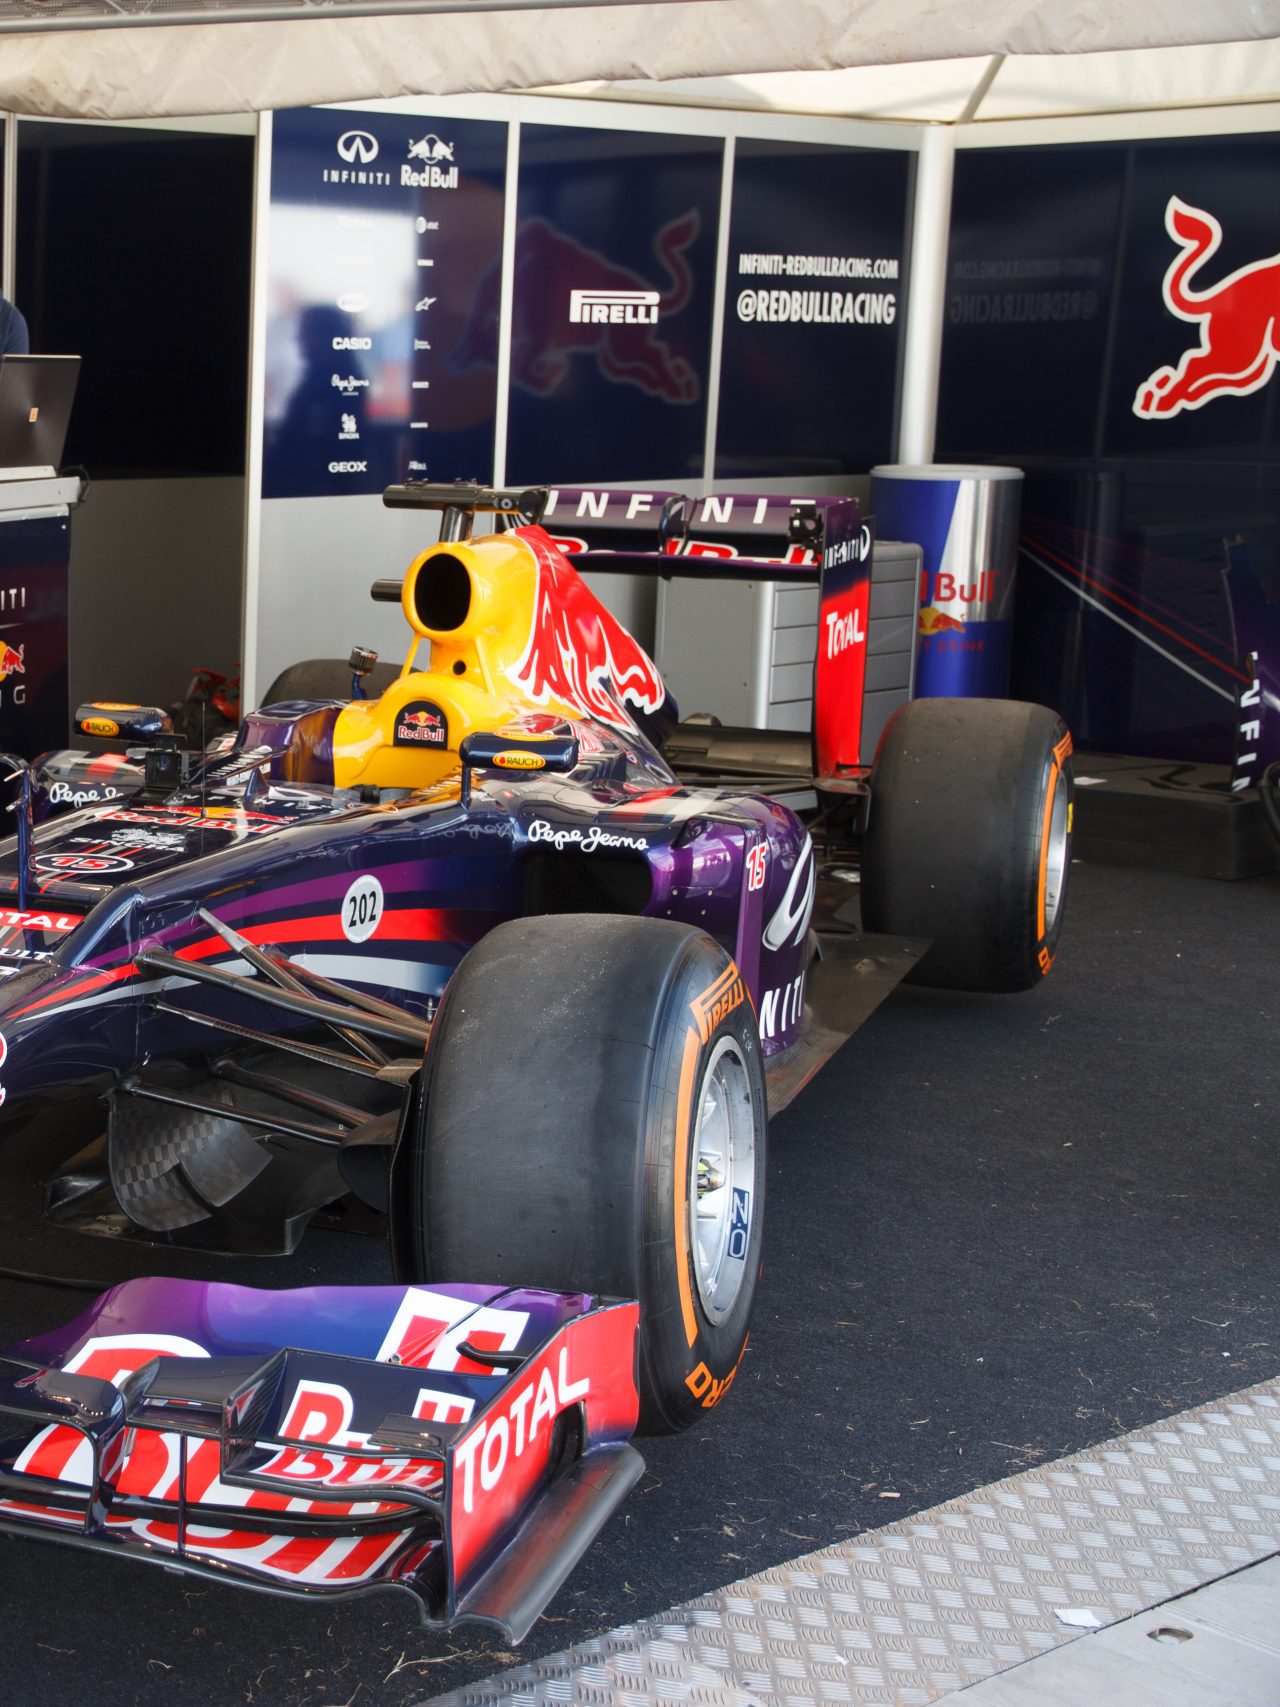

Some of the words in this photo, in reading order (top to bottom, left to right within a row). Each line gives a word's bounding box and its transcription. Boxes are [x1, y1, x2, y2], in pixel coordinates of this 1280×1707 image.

[323, 169, 390, 186] INFINITI
[400, 164, 430, 187] Red
[431, 166, 459, 189] Bull
[739, 253, 899, 280] INFINITI-REDBULLRACING.COM
[569, 289, 661, 324] PIRELLI
[736, 289, 897, 325] @REDBULLRACING
[332, 337, 372, 351] CASIO
[328, 461, 368, 473] GEOX
[934, 572, 995, 604] Bull
[826, 608, 865, 660] TOTAL
[398, 725, 421, 740] Red
[420, 727, 444, 743] Bull
[506, 756, 539, 766] RAUCH
[50, 782, 101, 808] Pepe
[93, 810, 194, 827] Red
[528, 820, 583, 851] Pepe
[580, 827, 649, 853] Jeans
[51, 855, 119, 870] 15
[746, 842, 768, 891] 15
[348, 890, 377, 928] 202
[688, 960, 745, 1045] PIRELLI
[455, 1346, 590, 1513] TOTAL
